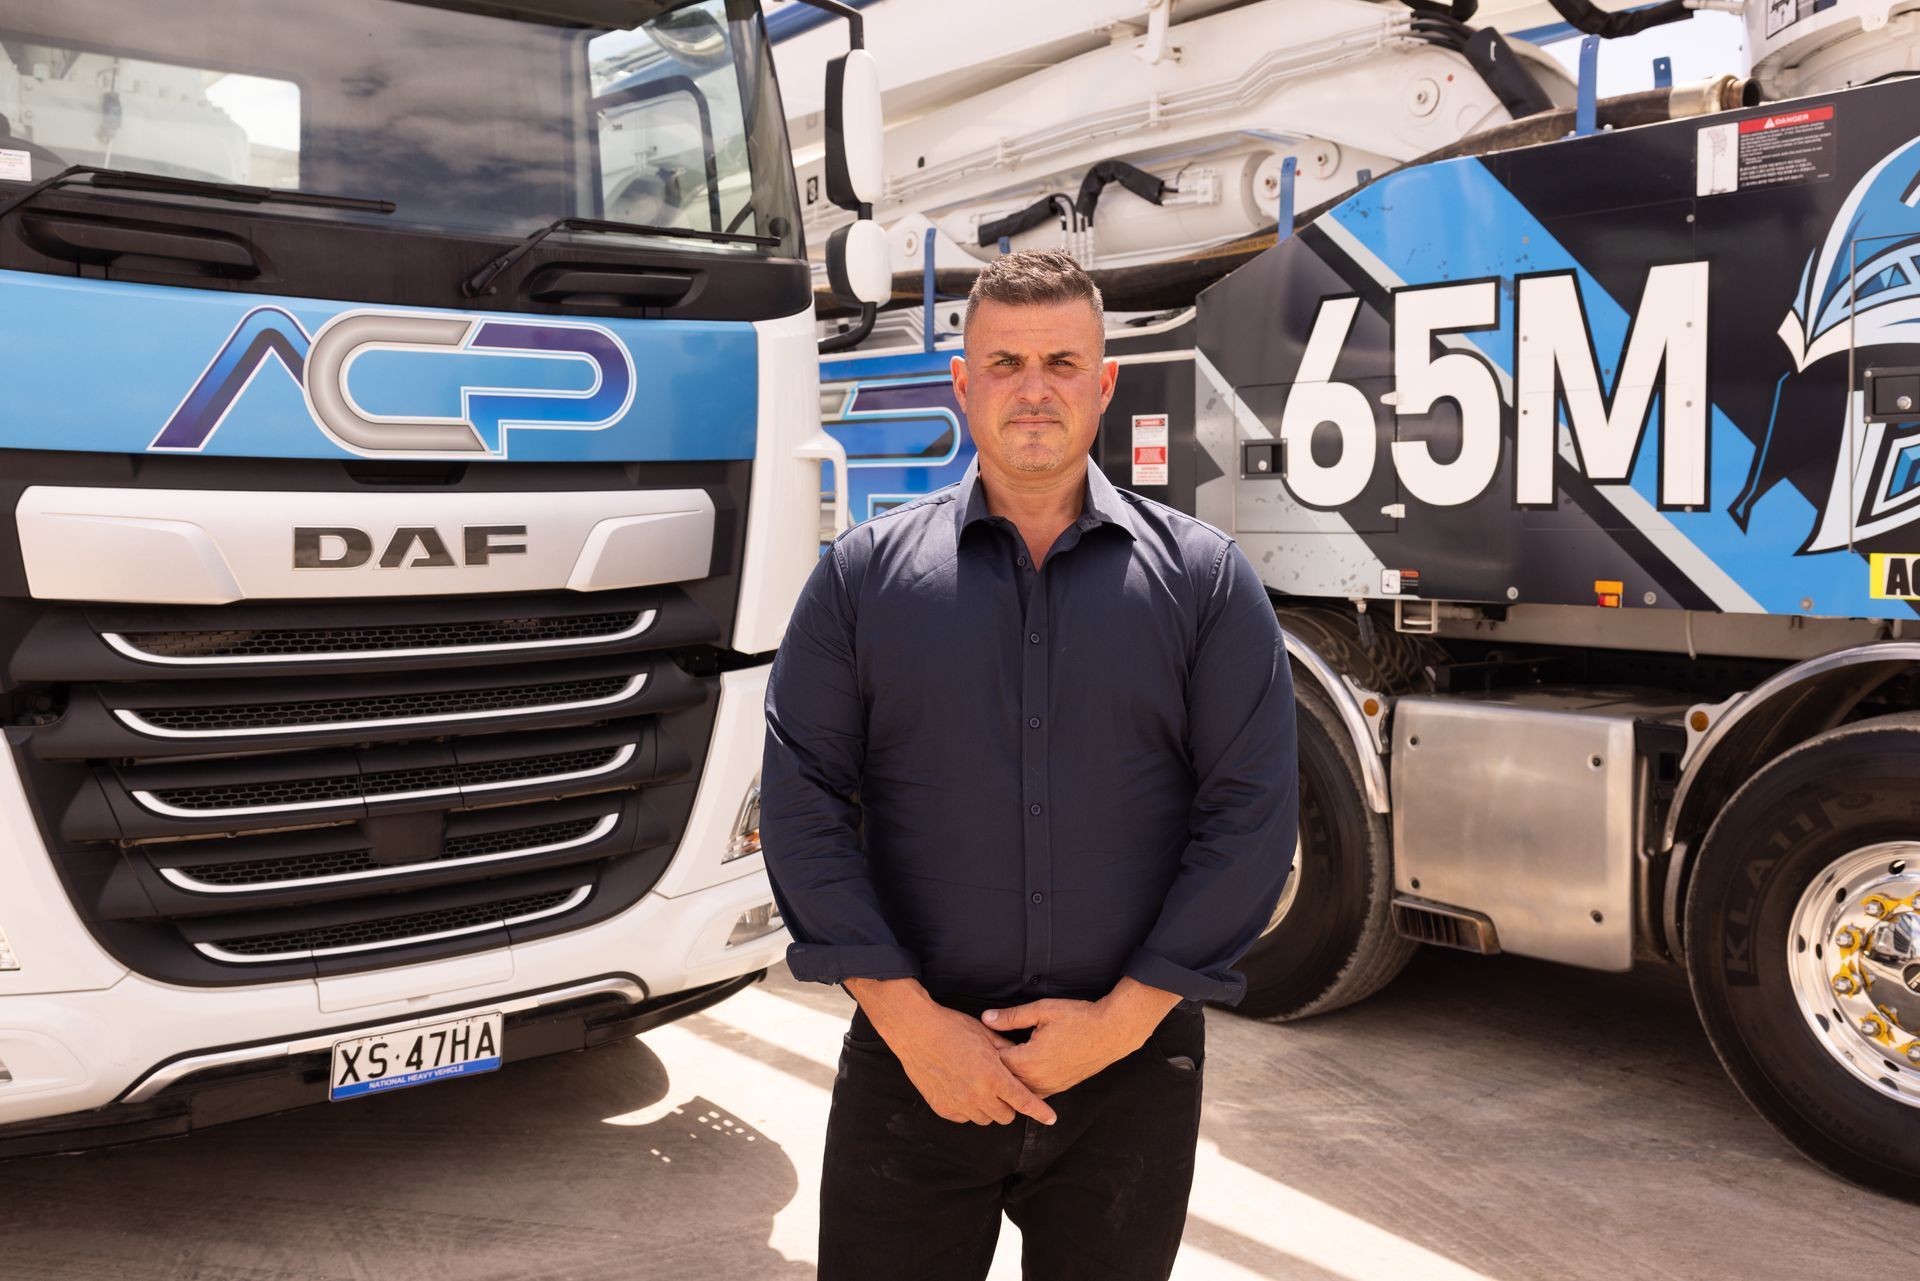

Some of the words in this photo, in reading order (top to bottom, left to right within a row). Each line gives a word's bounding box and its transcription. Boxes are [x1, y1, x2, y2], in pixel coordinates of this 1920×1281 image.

[1775, 113, 1809, 126] DANGER
[146, 304, 637, 460] ACP
[1280, 260, 1710, 507] 65M
[291, 523, 528, 570] DAF
[368, 1077, 406, 1090] NATIONAL
[407, 1071, 433, 1082] HEAVY
[434, 1064, 465, 1076] VEHICLE
